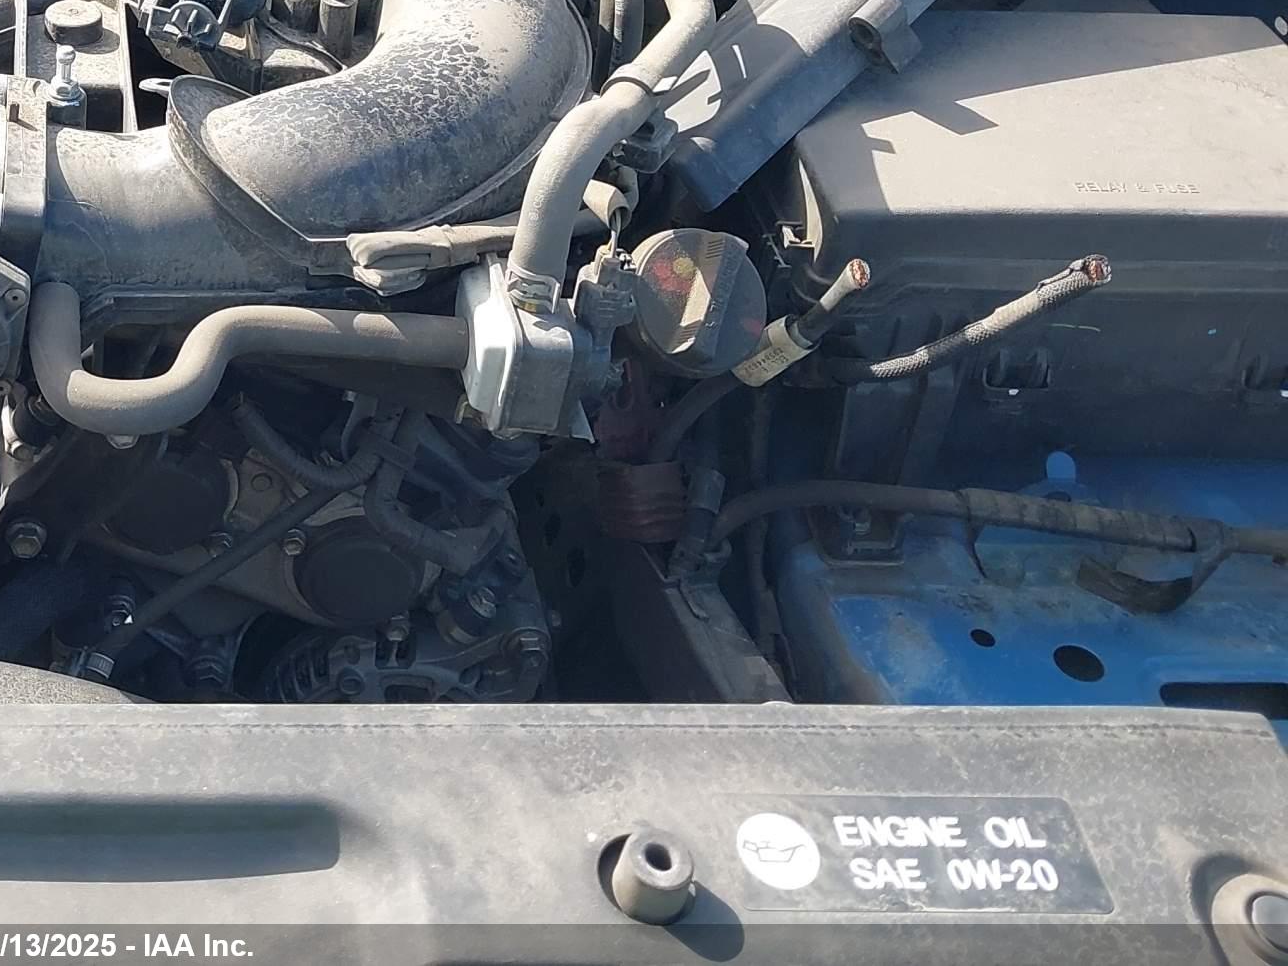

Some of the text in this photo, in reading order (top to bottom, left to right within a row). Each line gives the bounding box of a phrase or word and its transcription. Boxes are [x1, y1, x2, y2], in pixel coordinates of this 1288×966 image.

[1074, 181, 1128, 193] RELAY
[1155, 183, 1201, 194] FUSE
[833, 815, 1047, 848] ENGINE OIL
[849, 857, 1059, 891] SAE 0W-20
